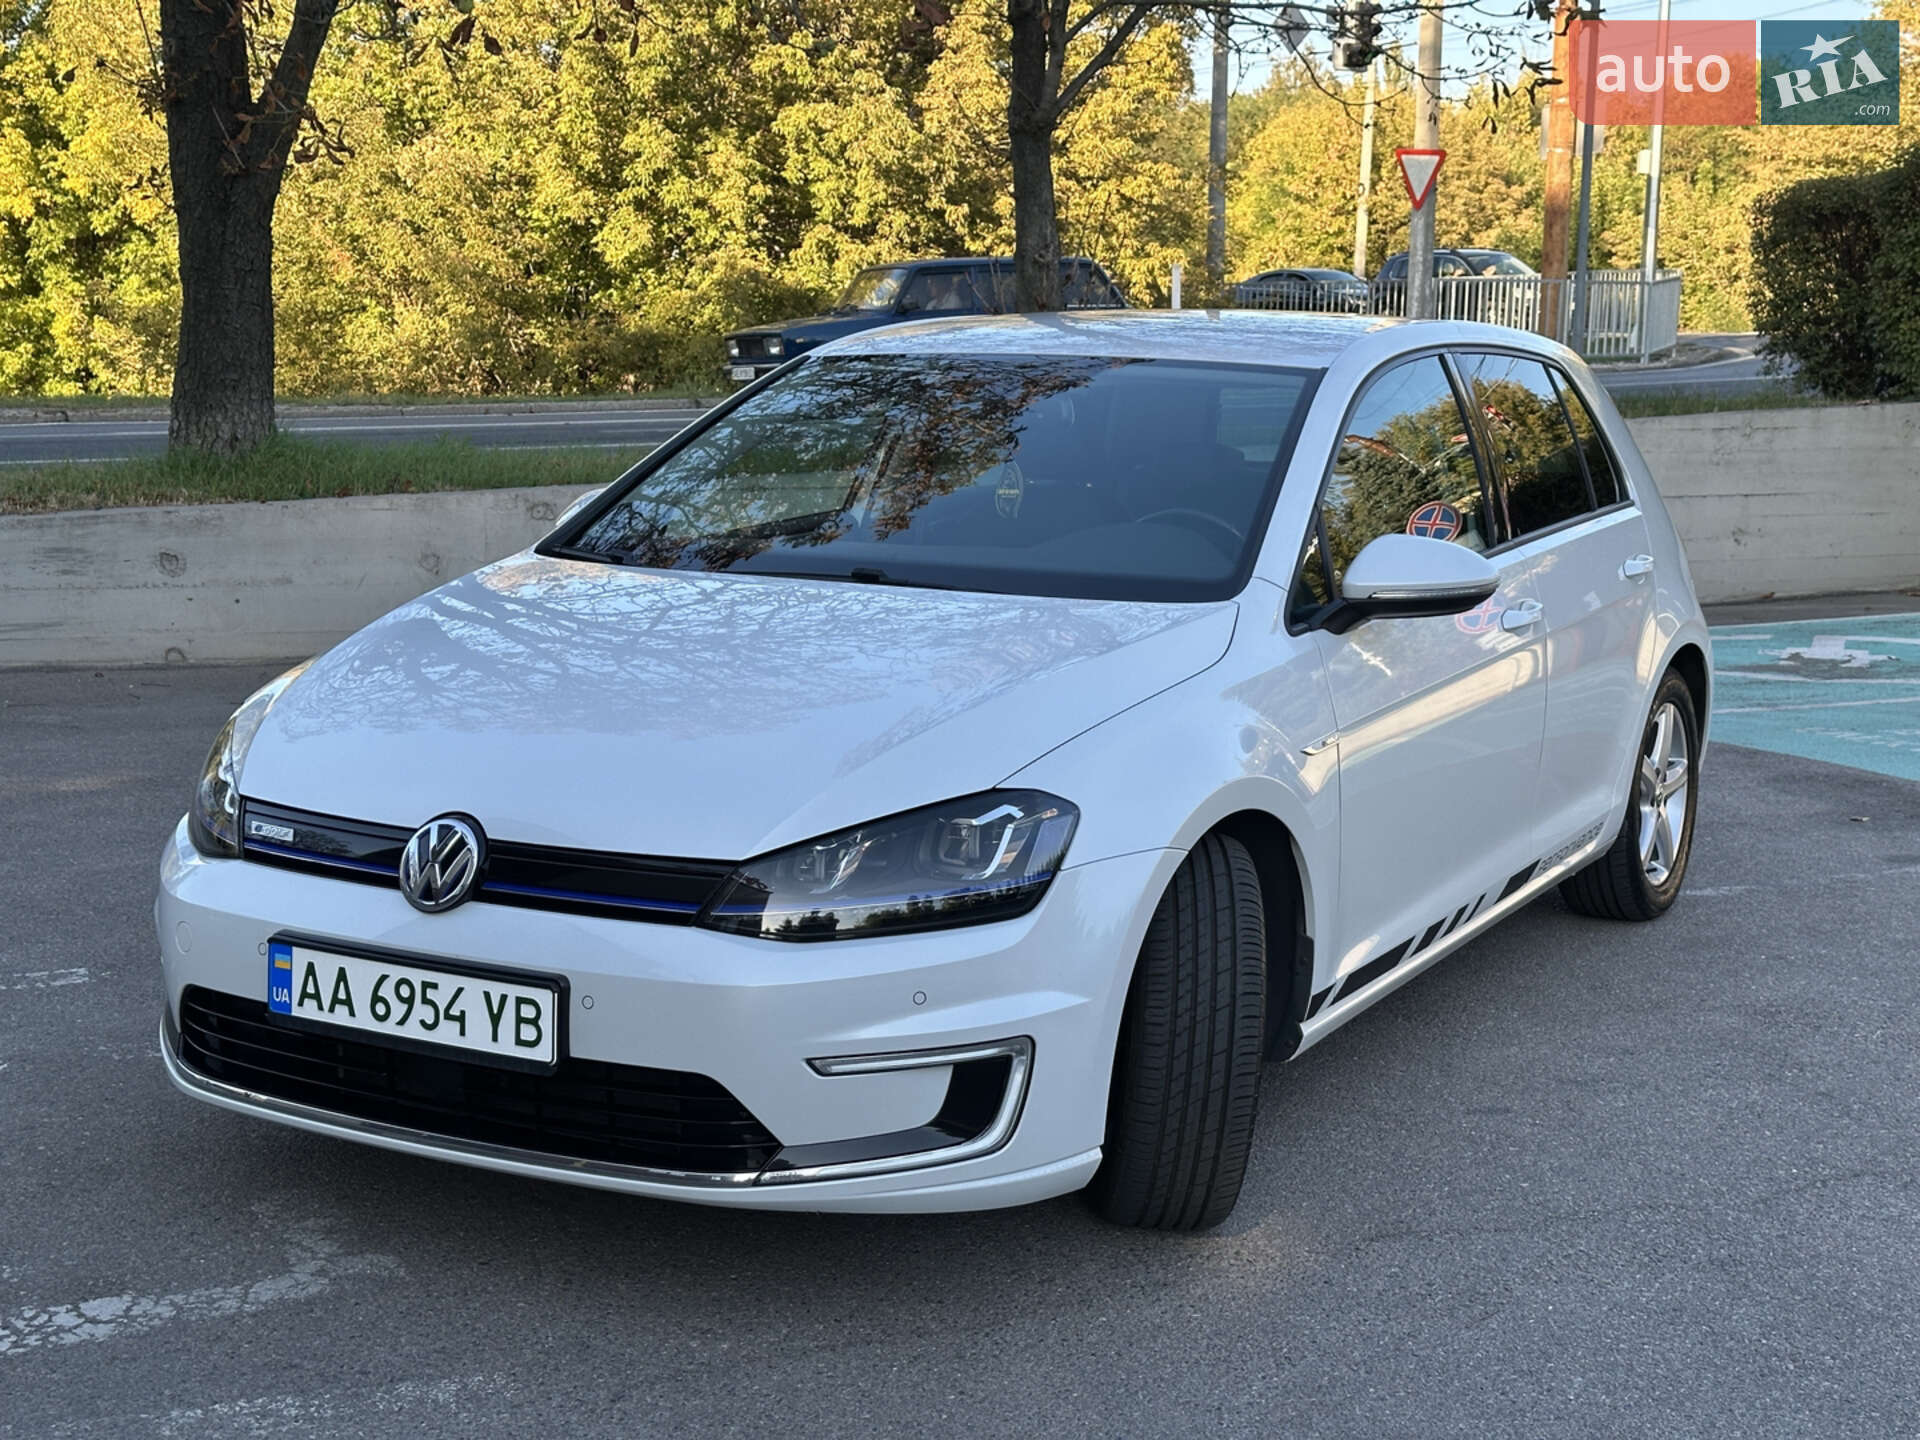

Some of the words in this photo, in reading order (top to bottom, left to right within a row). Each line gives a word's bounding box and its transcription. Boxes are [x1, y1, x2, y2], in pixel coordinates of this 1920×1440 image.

[273, 986, 290, 1004] UA
[297, 961, 356, 1018] AA
[369, 974, 466, 1037] 6954
[483, 990, 543, 1049] YB
